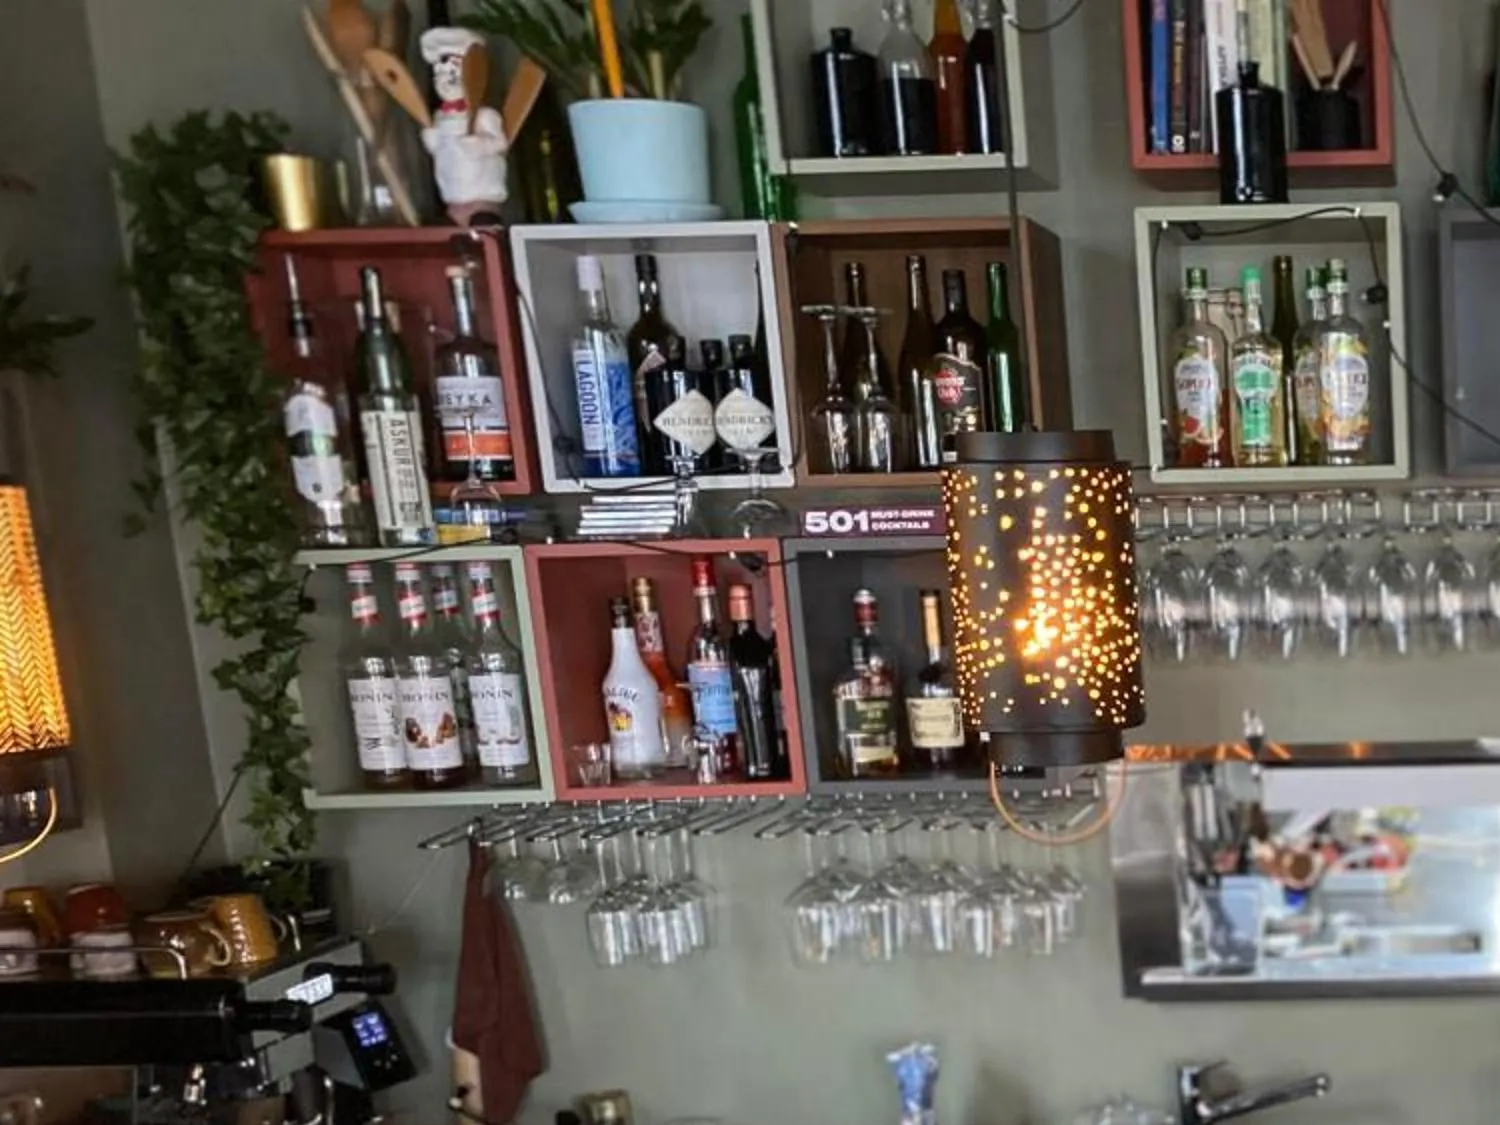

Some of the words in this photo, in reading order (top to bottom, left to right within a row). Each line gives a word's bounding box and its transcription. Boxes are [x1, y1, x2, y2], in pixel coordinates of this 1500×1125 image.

[574, 360, 601, 425] LAGOON
[804, 509, 869, 533] 501
[870, 521, 931, 531] COCKTAILS
